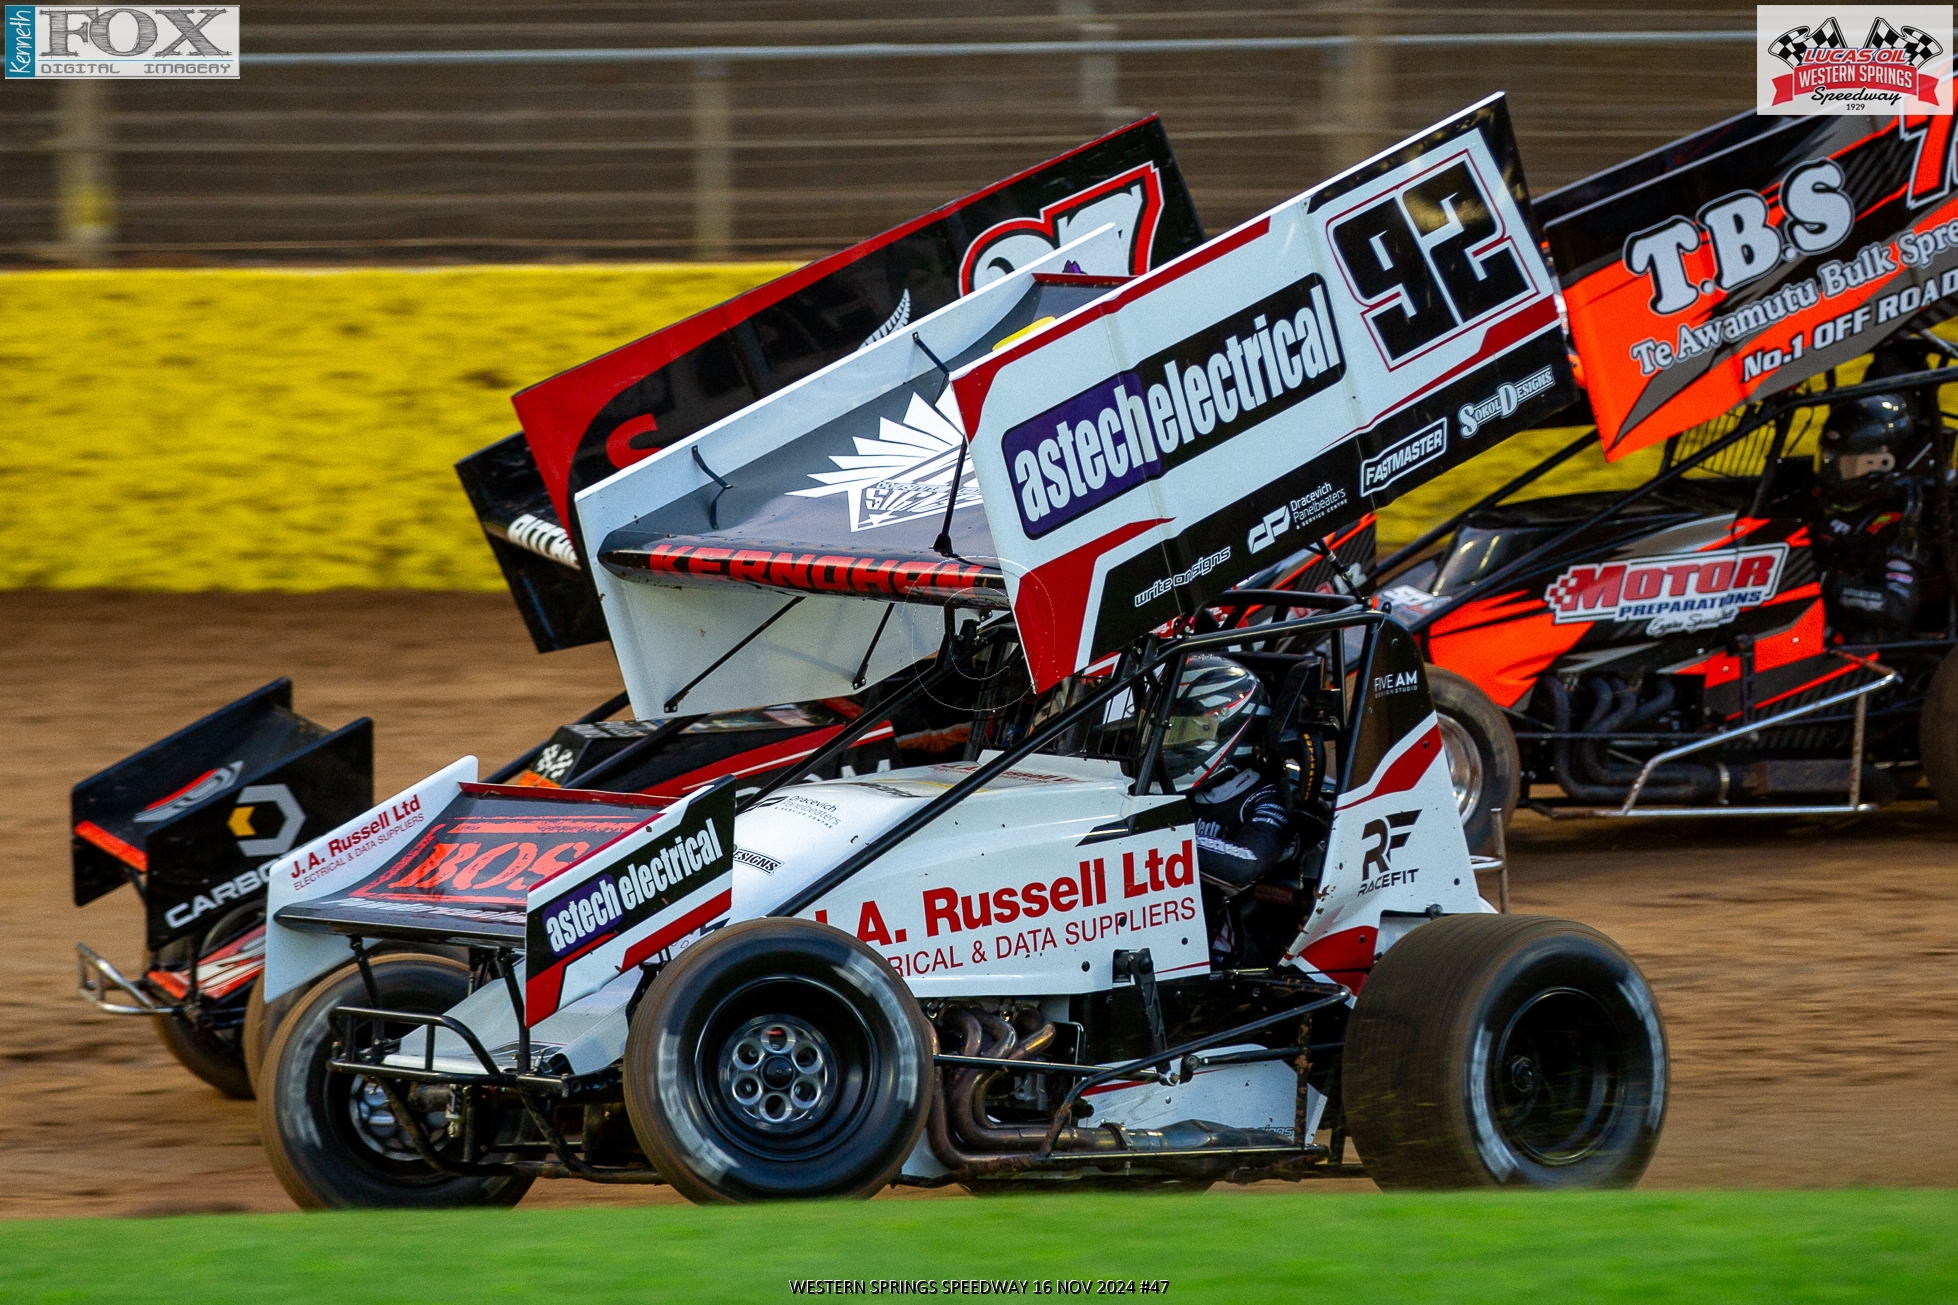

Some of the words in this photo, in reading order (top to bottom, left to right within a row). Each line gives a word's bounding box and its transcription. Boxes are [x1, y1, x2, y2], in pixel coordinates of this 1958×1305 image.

[1332, 159, 1531, 361] 92
[1631, 337, 1674, 377] Te
[1675, 279, 1818, 361] Awamutu
[1818, 242, 1899, 299] Bulk
[1743, 333, 1804, 382] No.1
[1813, 307, 1871, 350] OFF
[1876, 268, 1958, 317] ROAD
[1365, 428, 1443, 486] FASTMASTER
[1290, 482, 1333, 512] Dracevich
[1293, 488, 1347, 523] Panelbeaters
[1301, 511, 1325, 527] SERVICE
[1326, 498, 1348, 513] CENTRE
[649, 544, 985, 597] KERNOHAN
[1191, 545, 1231, 580] signs
[1558, 554, 1776, 612] MOTOR
[1374, 673, 1394, 692] FIVE
[1395, 670, 1418, 687] AM
[1395, 685, 1418, 694] STUDIO
[293, 859, 347, 891] ELECTRICAL
[347, 852, 354, 862] &
[354, 840, 377, 857] DATA
[378, 813, 425, 845] SUPPLIERS
[328, 811, 391, 857] Russell
[392, 794, 421, 822] Ltd
[546, 878, 623, 953] astech
[618, 817, 724, 911] electrical
[733, 849, 780, 874] ESIGNS
[923, 858, 1107, 938] Russell
[1122, 839, 1195, 899] Ltd
[1357, 868, 1420, 898] RACEFIT
[971, 939, 988, 964] &
[995, 927, 1058, 960] DATA
[1065, 897, 1196, 945] SUPPLIERS
